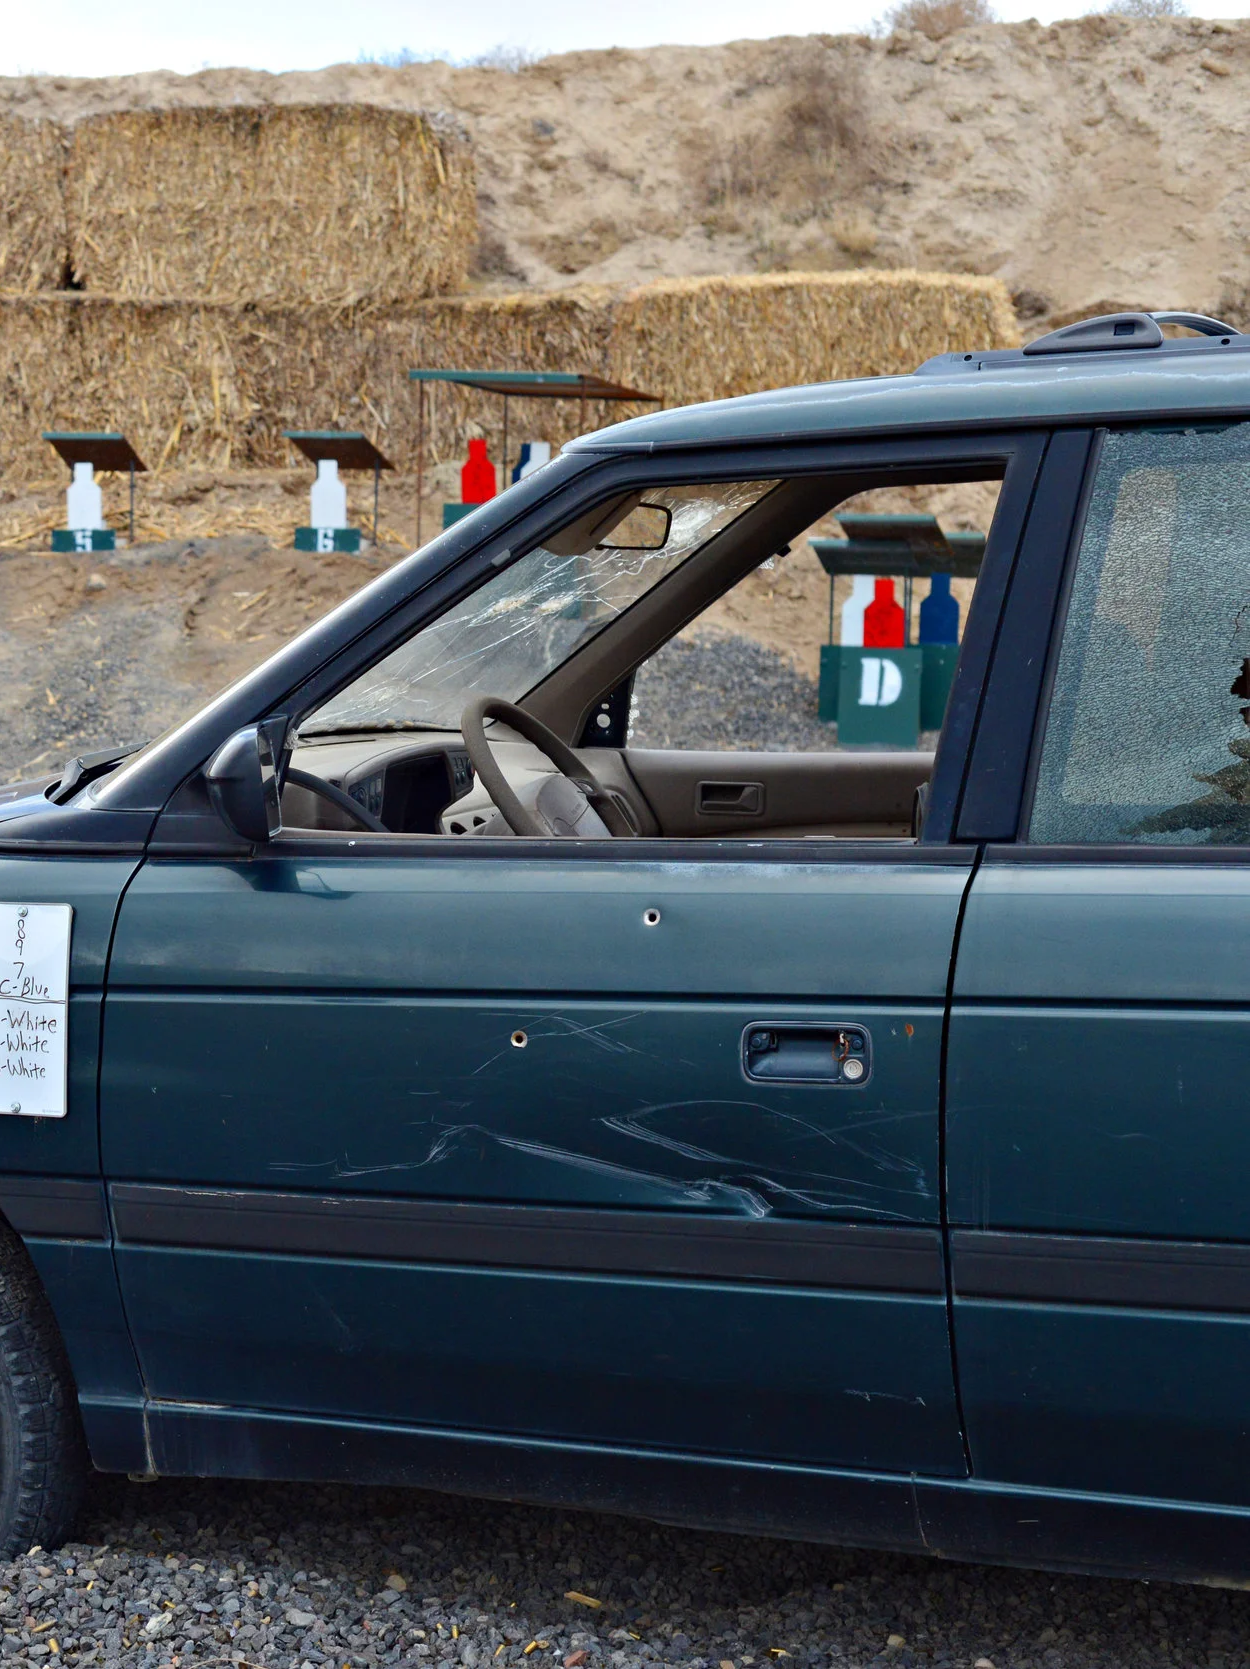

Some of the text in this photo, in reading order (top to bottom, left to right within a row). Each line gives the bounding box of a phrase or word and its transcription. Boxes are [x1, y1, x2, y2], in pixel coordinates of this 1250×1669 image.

[73, 530, 92, 552] 5
[858, 657, 902, 706] D
[17, 919, 26, 939] 8
[15, 939, 24, 956] 9
[13, 962, 25, 979] 7
